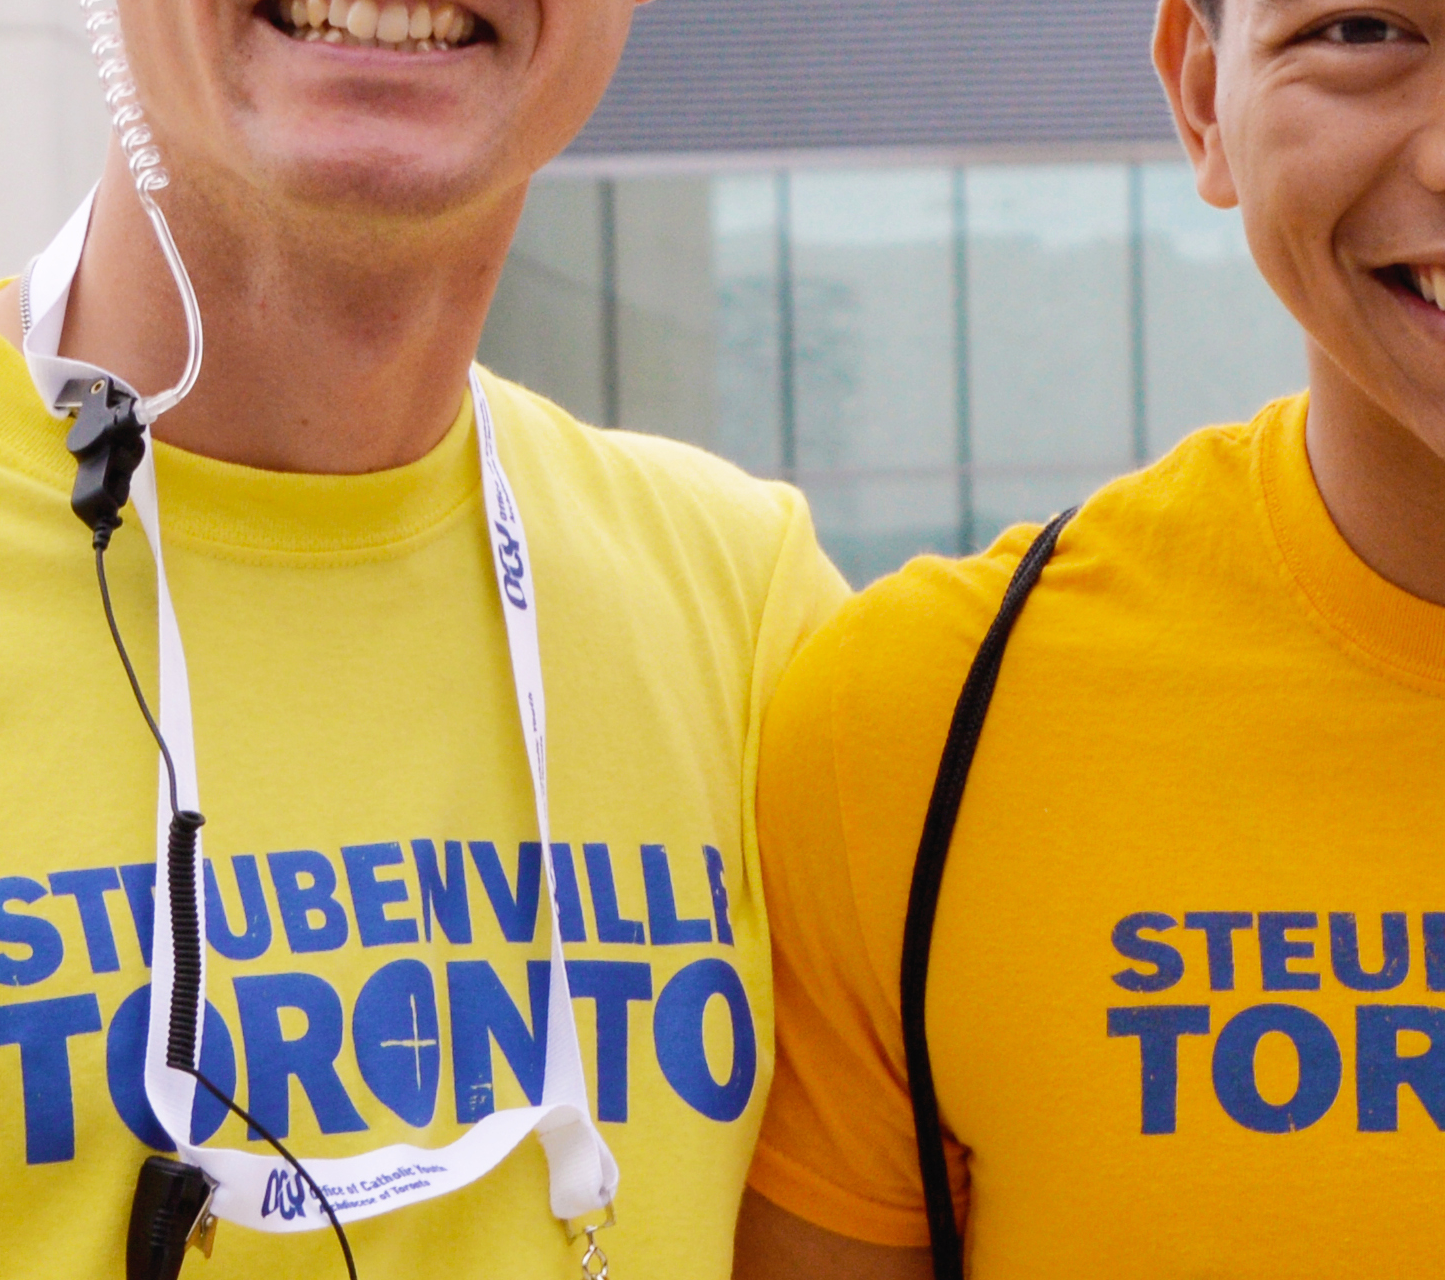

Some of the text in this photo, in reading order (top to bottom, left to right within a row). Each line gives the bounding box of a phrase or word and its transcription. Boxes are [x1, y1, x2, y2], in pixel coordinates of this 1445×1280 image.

[309, 1184, 344, 1199] Ofice
[347, 1182, 359, 1197] of
[360, 1165, 415, 1192] Catholic
[319, 1197, 375, 1213] Achdiocese
[392, 1179, 430, 1194] Toronto
